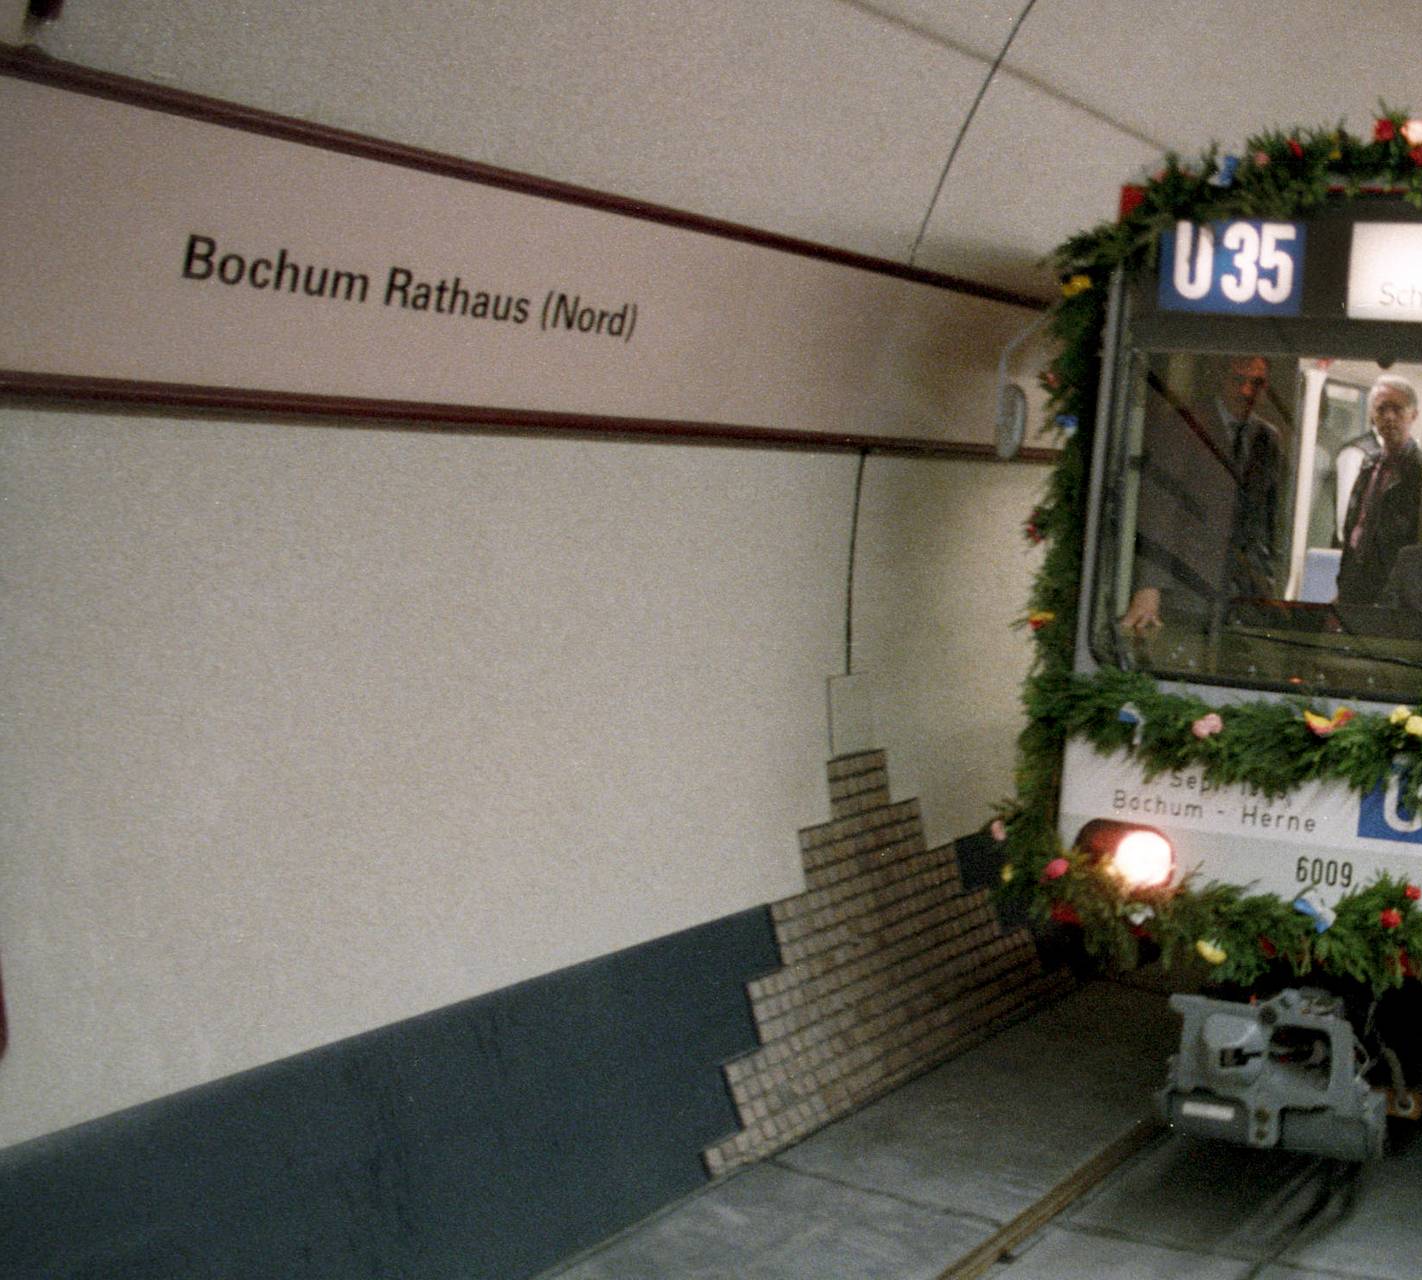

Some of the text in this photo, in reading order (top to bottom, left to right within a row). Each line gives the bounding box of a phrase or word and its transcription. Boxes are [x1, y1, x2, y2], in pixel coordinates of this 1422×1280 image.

[182, 234, 638, 342] Bochum Rathaus (Nord)
[1173, 219, 1297, 304] U 35
[1113, 789, 1203, 818] Bochum
[1241, 804, 1317, 832] Herne
[1296, 856, 1353, 888] 6009
